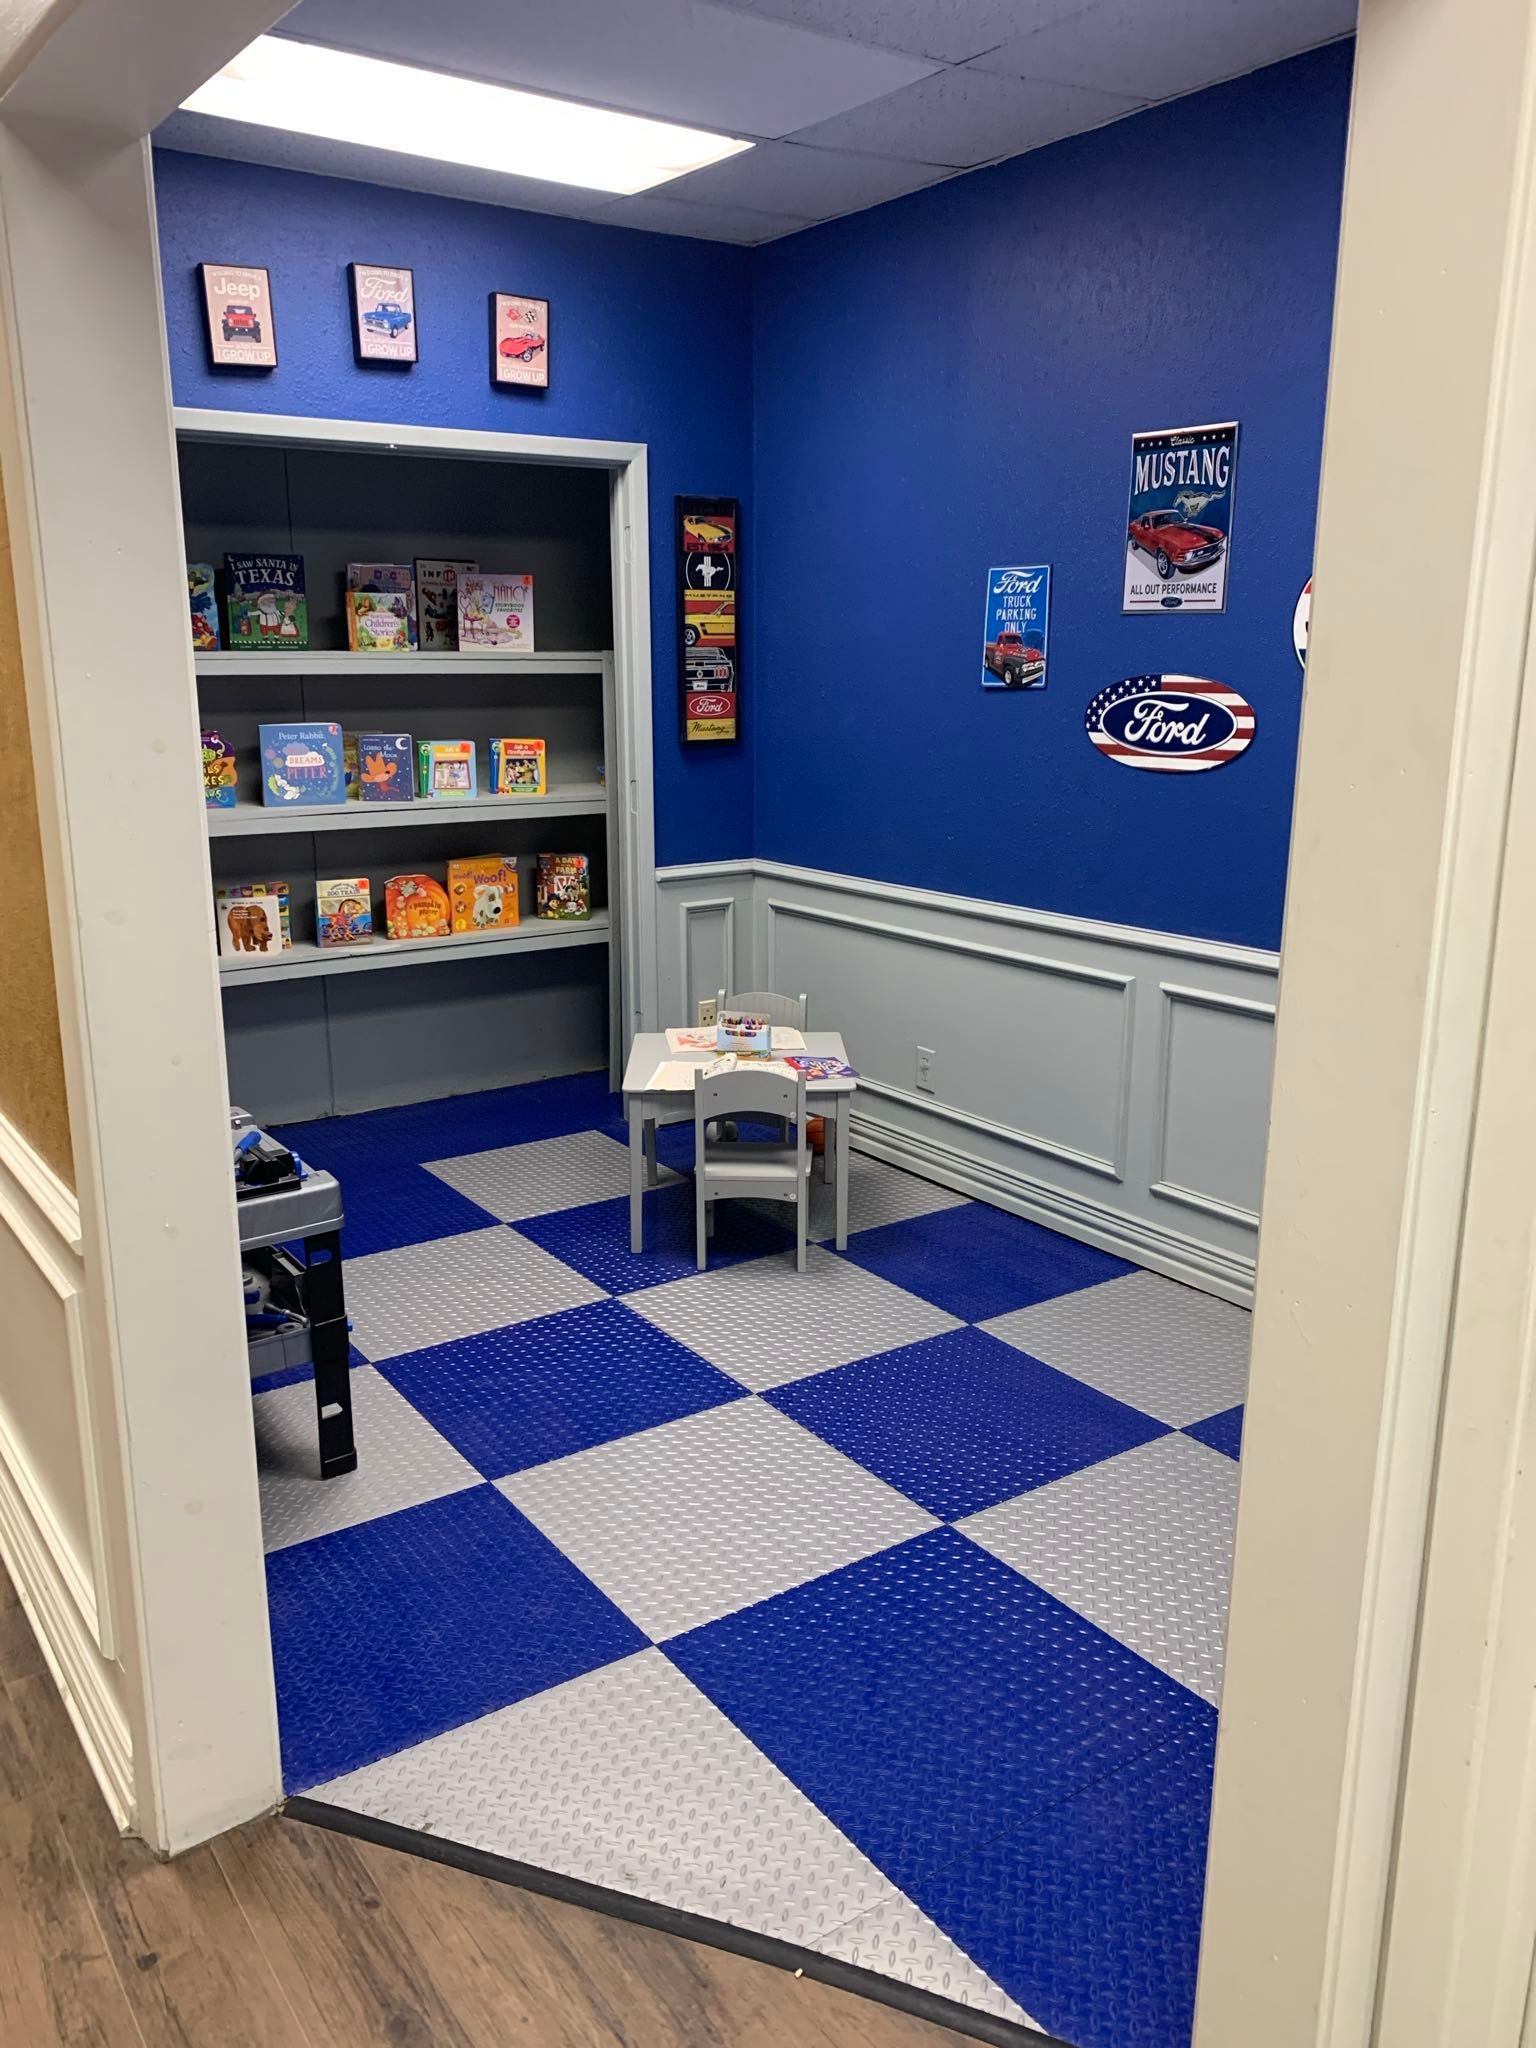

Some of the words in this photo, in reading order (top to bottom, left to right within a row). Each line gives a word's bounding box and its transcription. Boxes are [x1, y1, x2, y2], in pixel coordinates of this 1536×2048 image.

[213, 277, 261, 301] Jeep
[360, 276, 409, 303] Ford
[216, 349, 221, 360] I
[222, 349, 256, 361] GROW
[257, 351, 272, 362] UP
[363, 342, 367, 354] I
[368, 343, 398, 356] GROW
[399, 345, 413, 358] UP
[499, 367, 503, 378] I
[503, 369, 530, 381] GROW
[531, 371, 545, 383] UP
[1170, 435, 1195, 446] Classic
[1134, 445, 1231, 496] MUSTANG
[236, 560, 253, 569] SAW
[256, 558, 286, 570] SANTA
[234, 568, 295, 586] TEXAS
[993, 570, 1043, 594] Ford
[493, 584, 528, 602] NANCY
[1130, 584, 1143, 595] ALL
[1144, 584, 1160, 595] OUT
[1161, 582, 1217, 595] PERFORMANCE
[1002, 595, 1032, 608] TRUCK
[996, 608, 1037, 621] PARKING
[365, 618, 400, 628] Children's
[1004, 621, 1027, 633] ONLY
[696, 698, 723, 712] Ford
[691, 721, 729, 735] Mustang
[1124, 698, 1209, 745] Ford
[279, 732, 298, 740] Peter
[299, 731, 324, 740] Rabbit
[289, 756, 323, 765] DREAMS
[287, 766, 327, 780] PETER
[555, 856, 561, 864] A
[562, 856, 576, 864] DAY
[474, 869, 507, 884] Woof!
[555, 866, 577, 874] FARM
[341, 887, 361, 896] TRAIN
[414, 900, 441, 910] pumpkin
